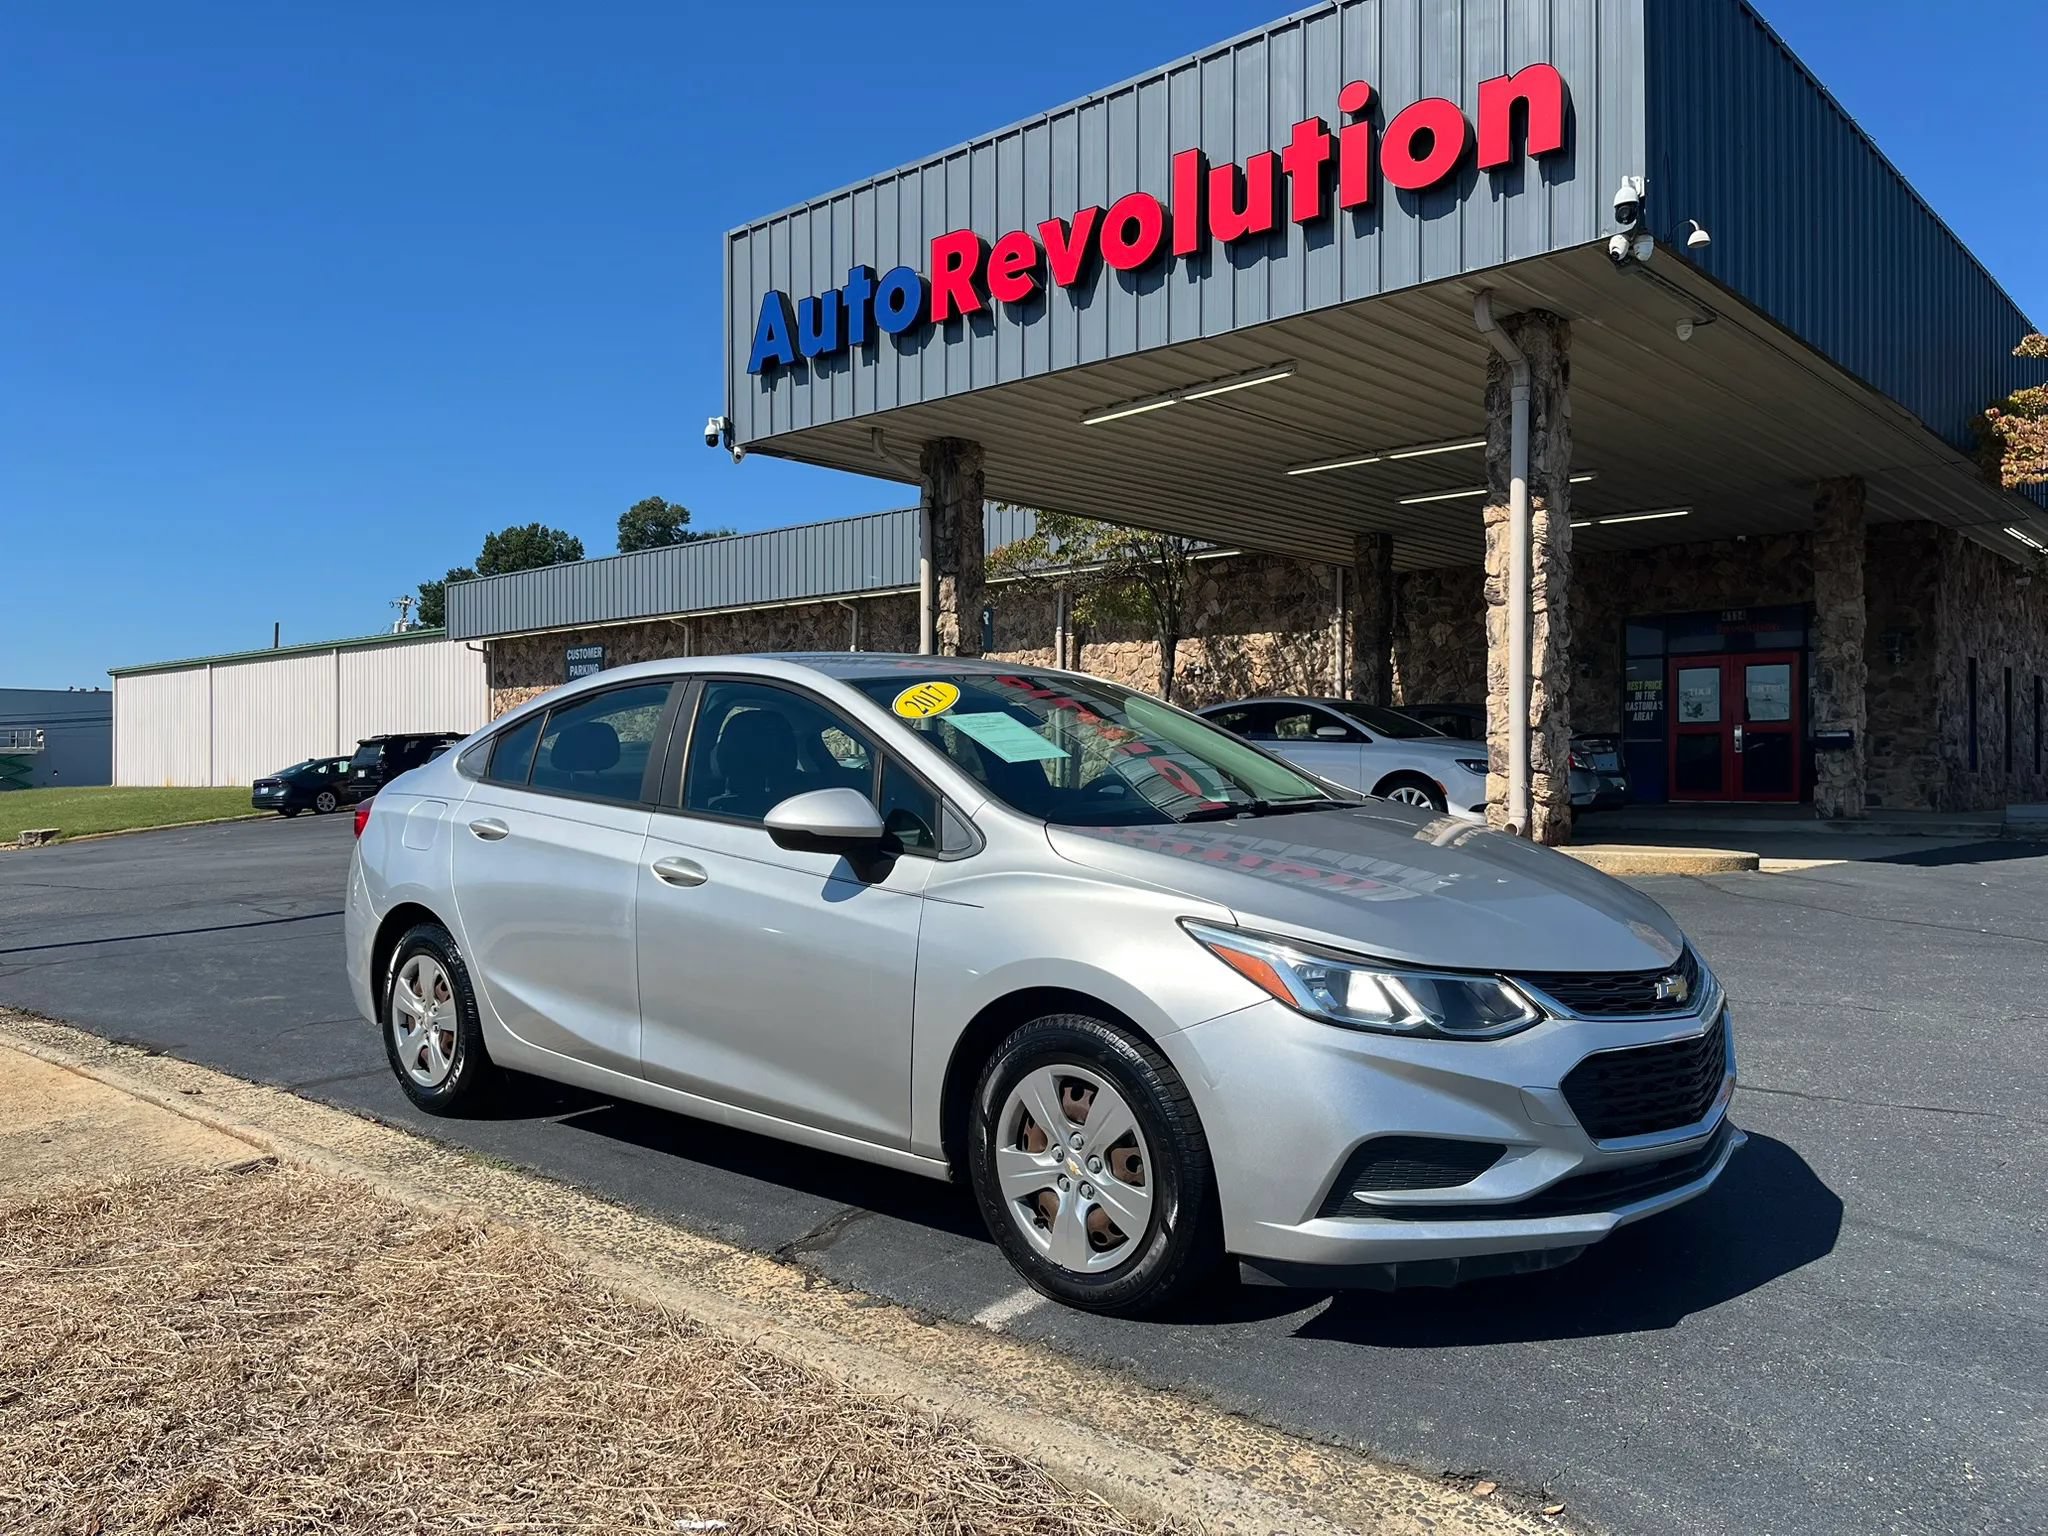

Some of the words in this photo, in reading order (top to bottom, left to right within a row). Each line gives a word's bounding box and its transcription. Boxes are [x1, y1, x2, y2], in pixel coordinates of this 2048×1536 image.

[566, 646, 603, 660] CUSTOMER
[569, 663, 599, 677] PARKING
[1644, 679, 1663, 690] PRICE
[904, 684, 947, 715] 2017
[1635, 691, 1643, 701] IN
[1644, 690, 1656, 700] THE
[1632, 711, 1653, 721] AREA!
